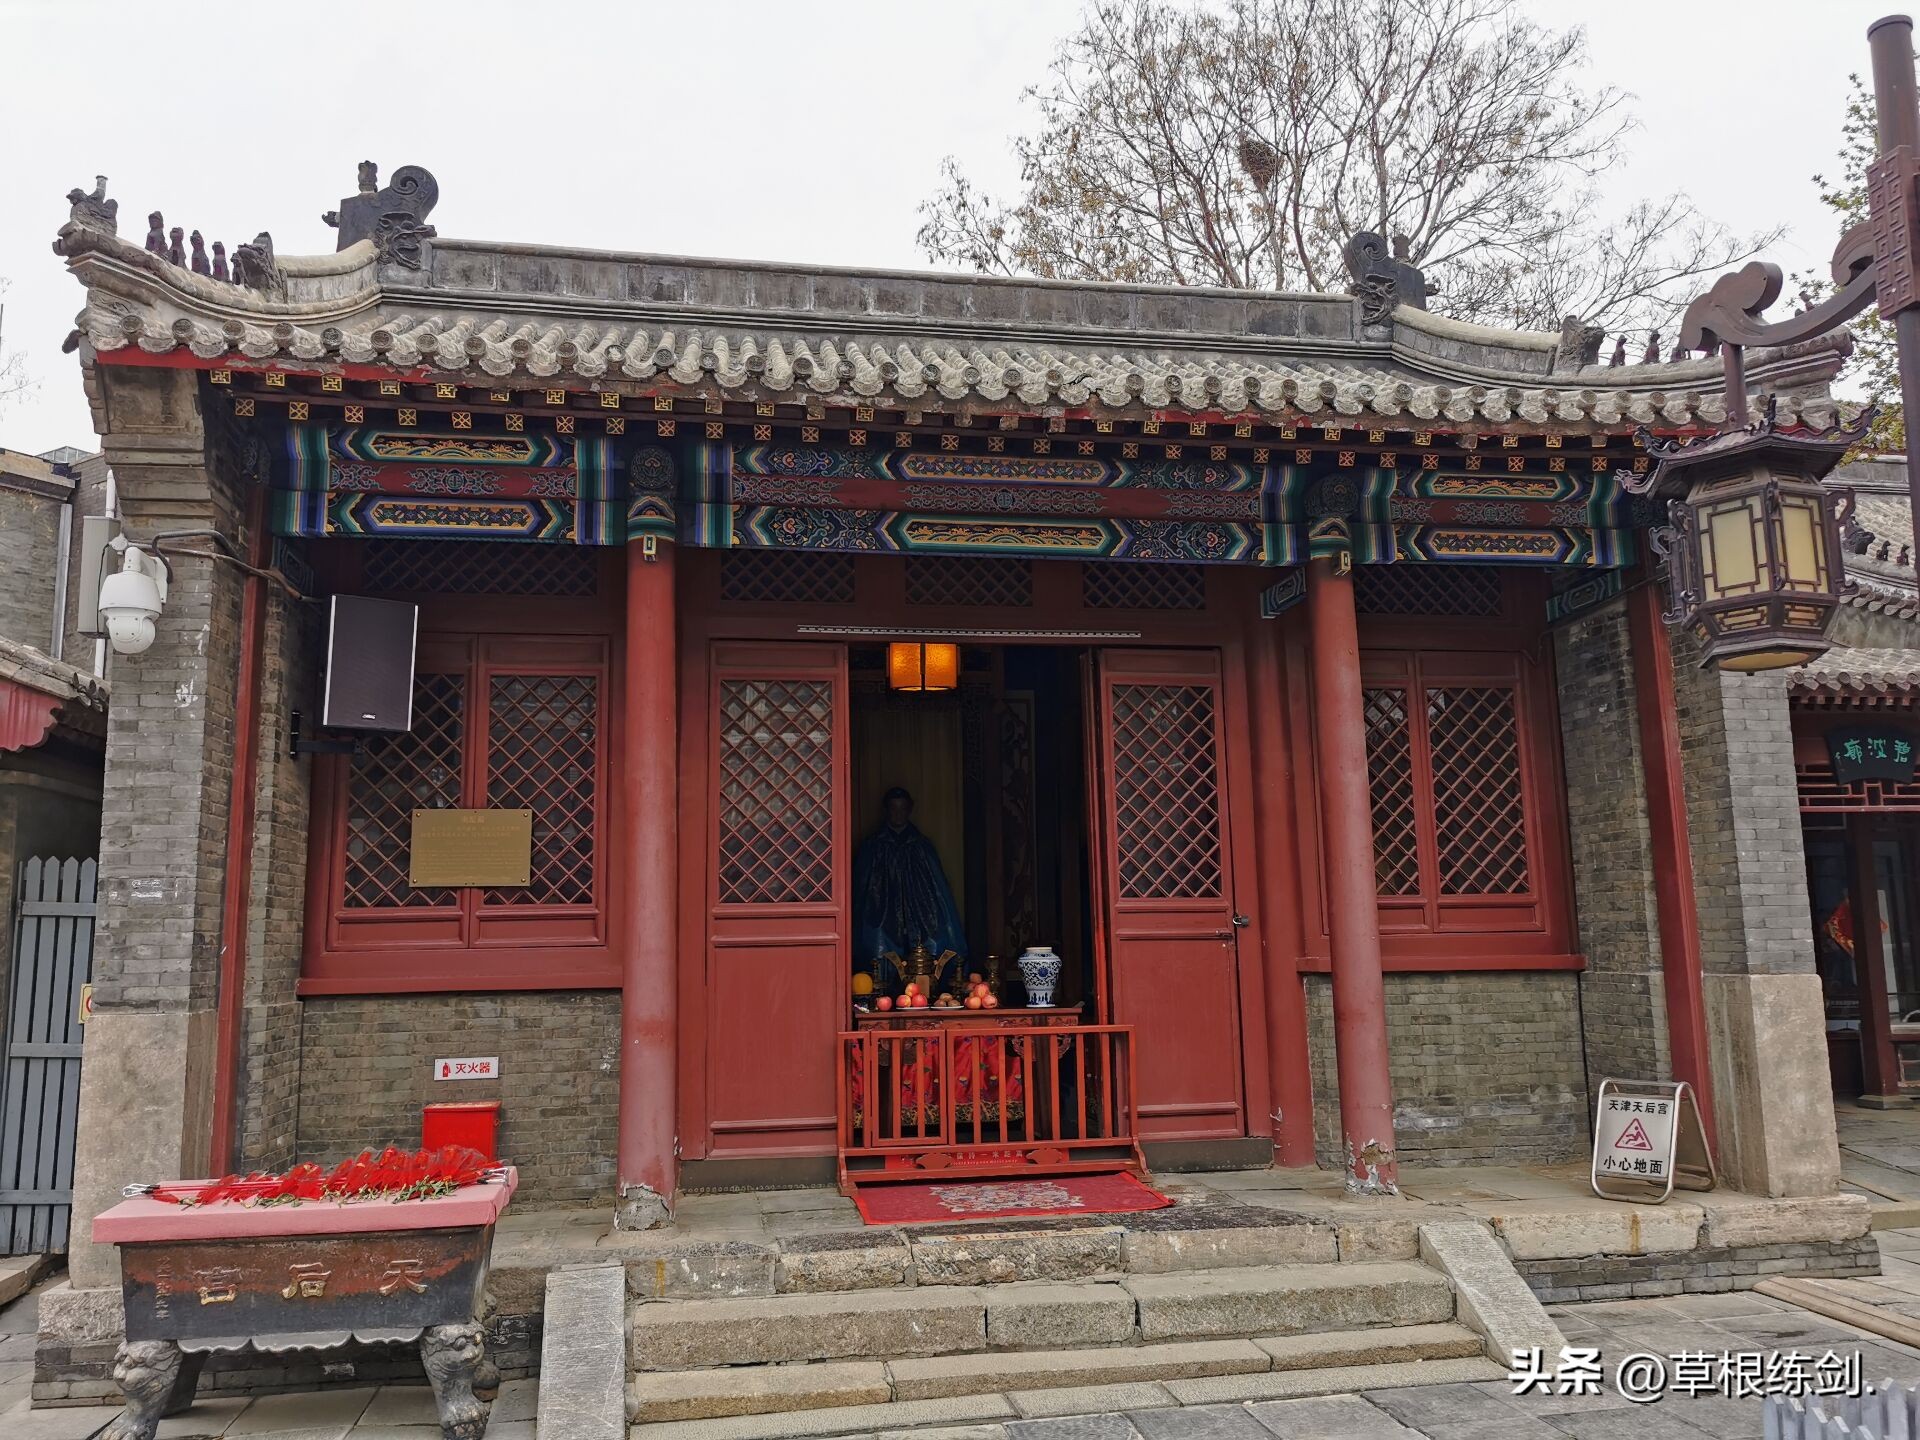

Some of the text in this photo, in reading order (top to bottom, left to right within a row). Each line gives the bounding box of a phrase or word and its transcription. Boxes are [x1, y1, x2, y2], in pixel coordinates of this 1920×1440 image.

[455, 1061, 490, 1074] 灭火器
[1608, 1099, 1668, 1114] 天津天后宫
[1603, 1155, 1663, 1174] 小心地面
